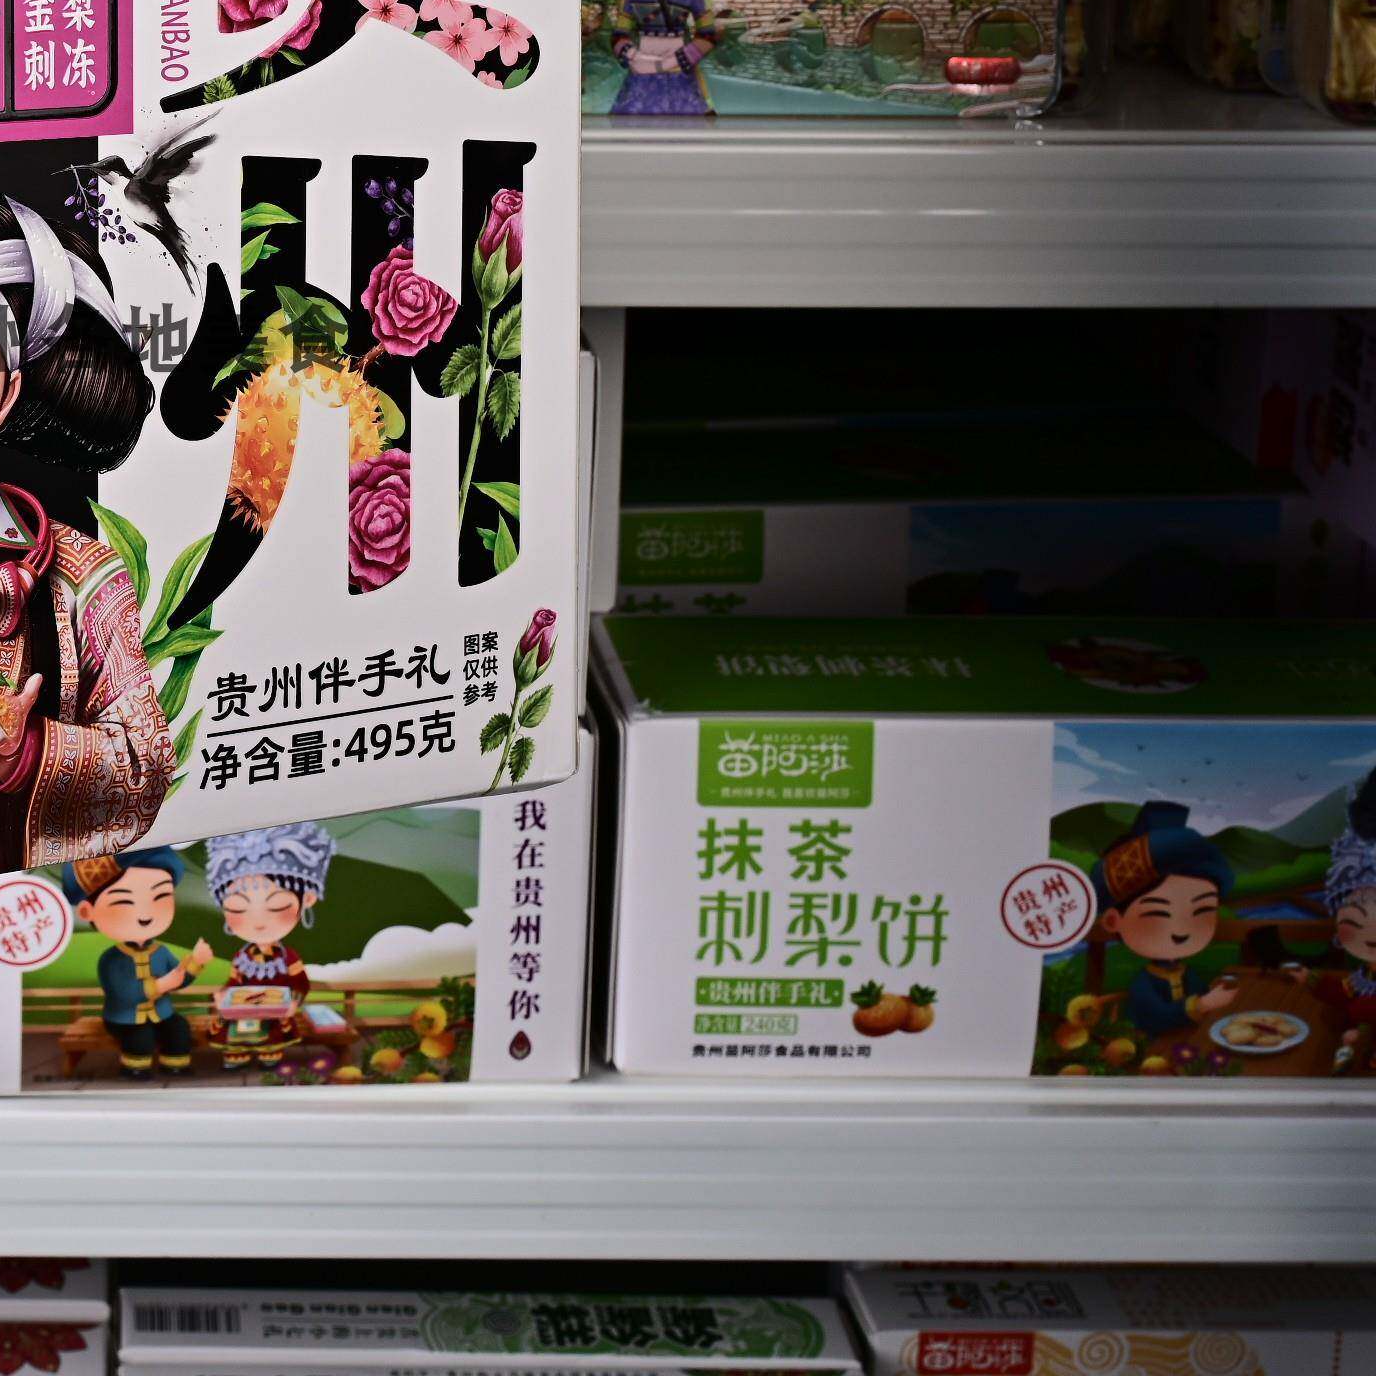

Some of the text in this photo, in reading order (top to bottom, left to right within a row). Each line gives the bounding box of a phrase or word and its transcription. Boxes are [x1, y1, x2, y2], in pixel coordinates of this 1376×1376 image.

[463, 630, 498, 657] 图案
[207, 644, 450, 721] 贵州伴手礼
[463, 655, 498, 680] 仅供
[463, 681, 498, 707] 参考
[199, 709, 455, 791] 净含量:495克
[697, 818, 854, 882] 抹茶
[508, 800, 547, 1021] 我在贵州等你
[1012, 873, 1072, 916] 贵州
[695, 890, 950, 968] 刺梨饼
[1023, 899, 1079, 942] 特产
[709, 979, 833, 1006] 贵州伴手礼
